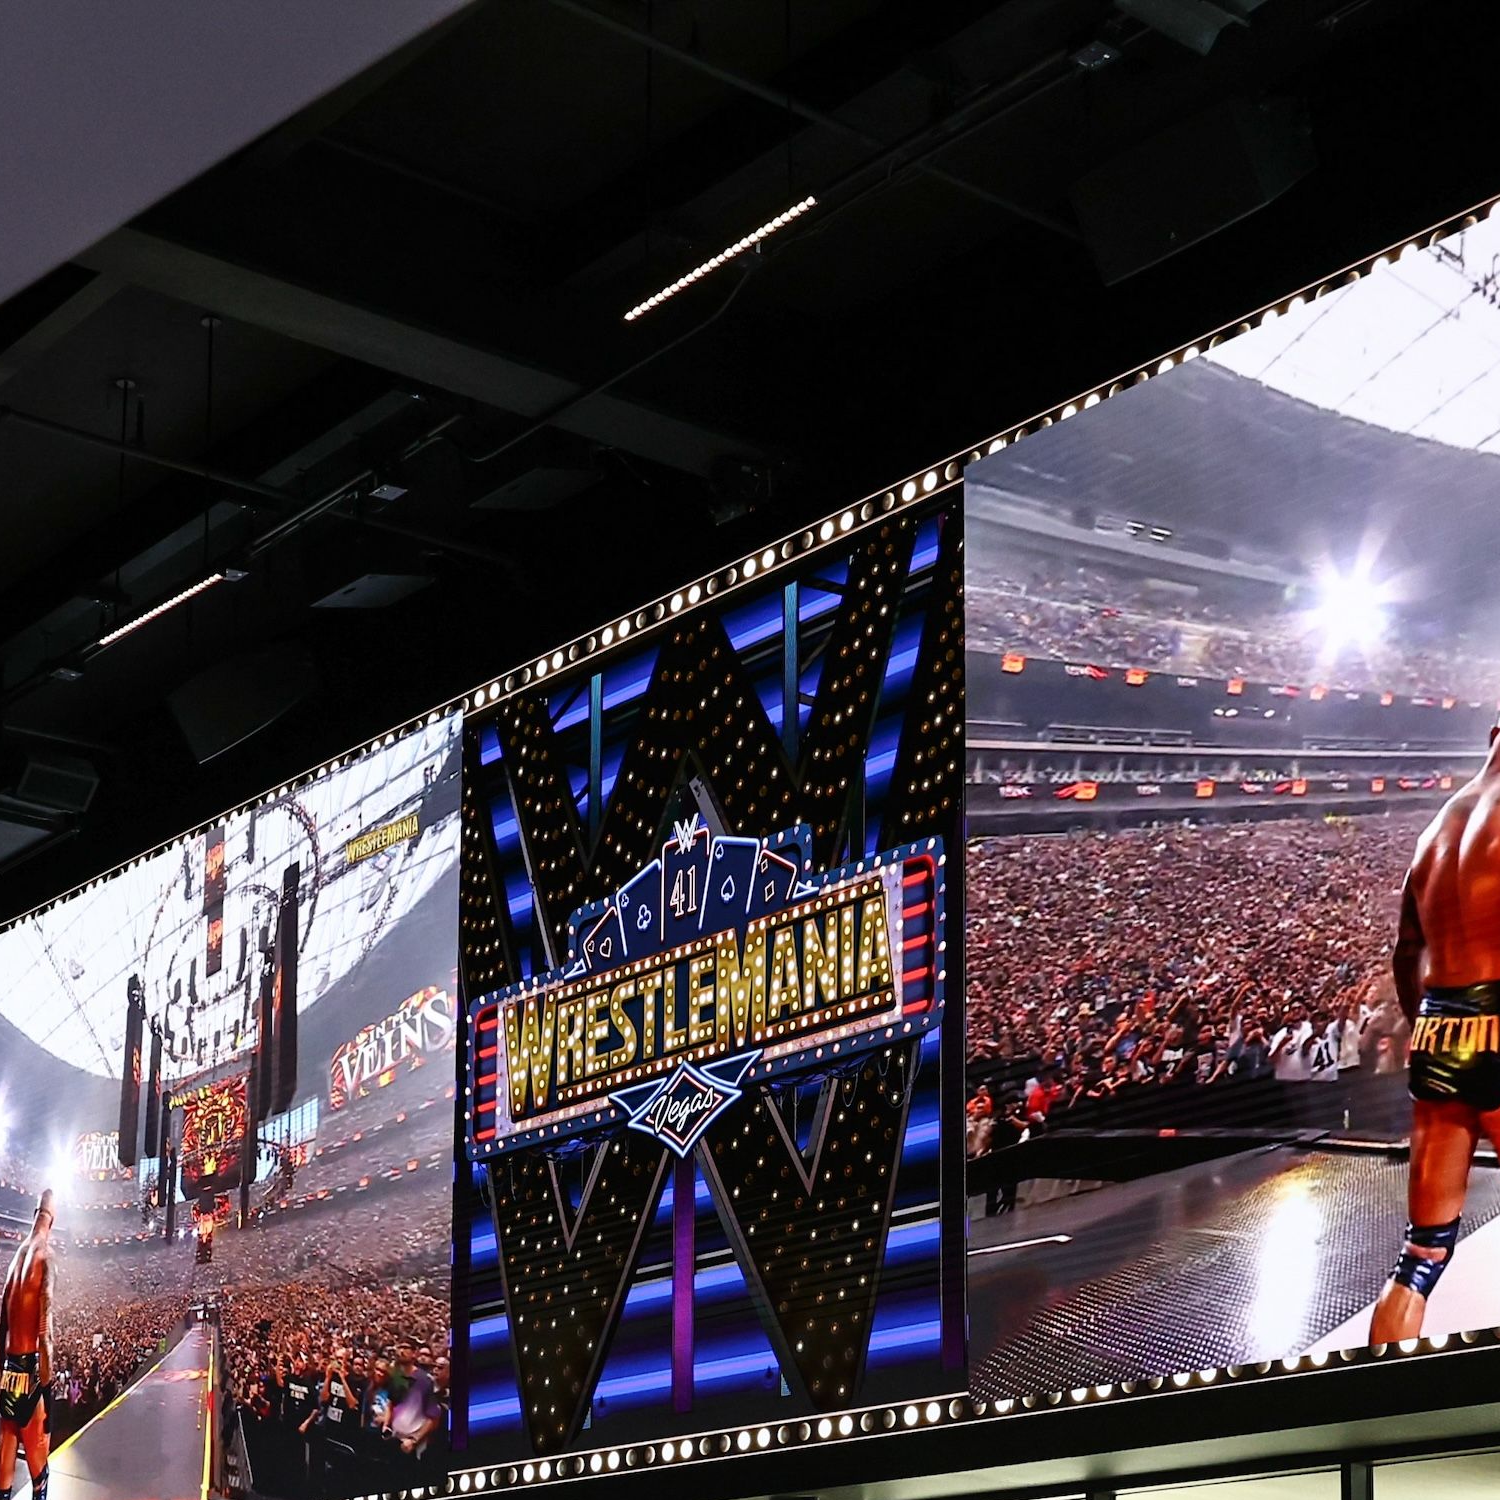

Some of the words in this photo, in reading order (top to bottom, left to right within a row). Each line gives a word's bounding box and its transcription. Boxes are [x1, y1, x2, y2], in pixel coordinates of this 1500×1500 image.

[669, 865, 697, 919] 41
[503, 899, 896, 1117] WRESTLEMANIA
[338, 990, 453, 1100] VEINS
[1410, 1014, 1499, 1058] ORTON
[650, 1086, 715, 1134] Vegas
